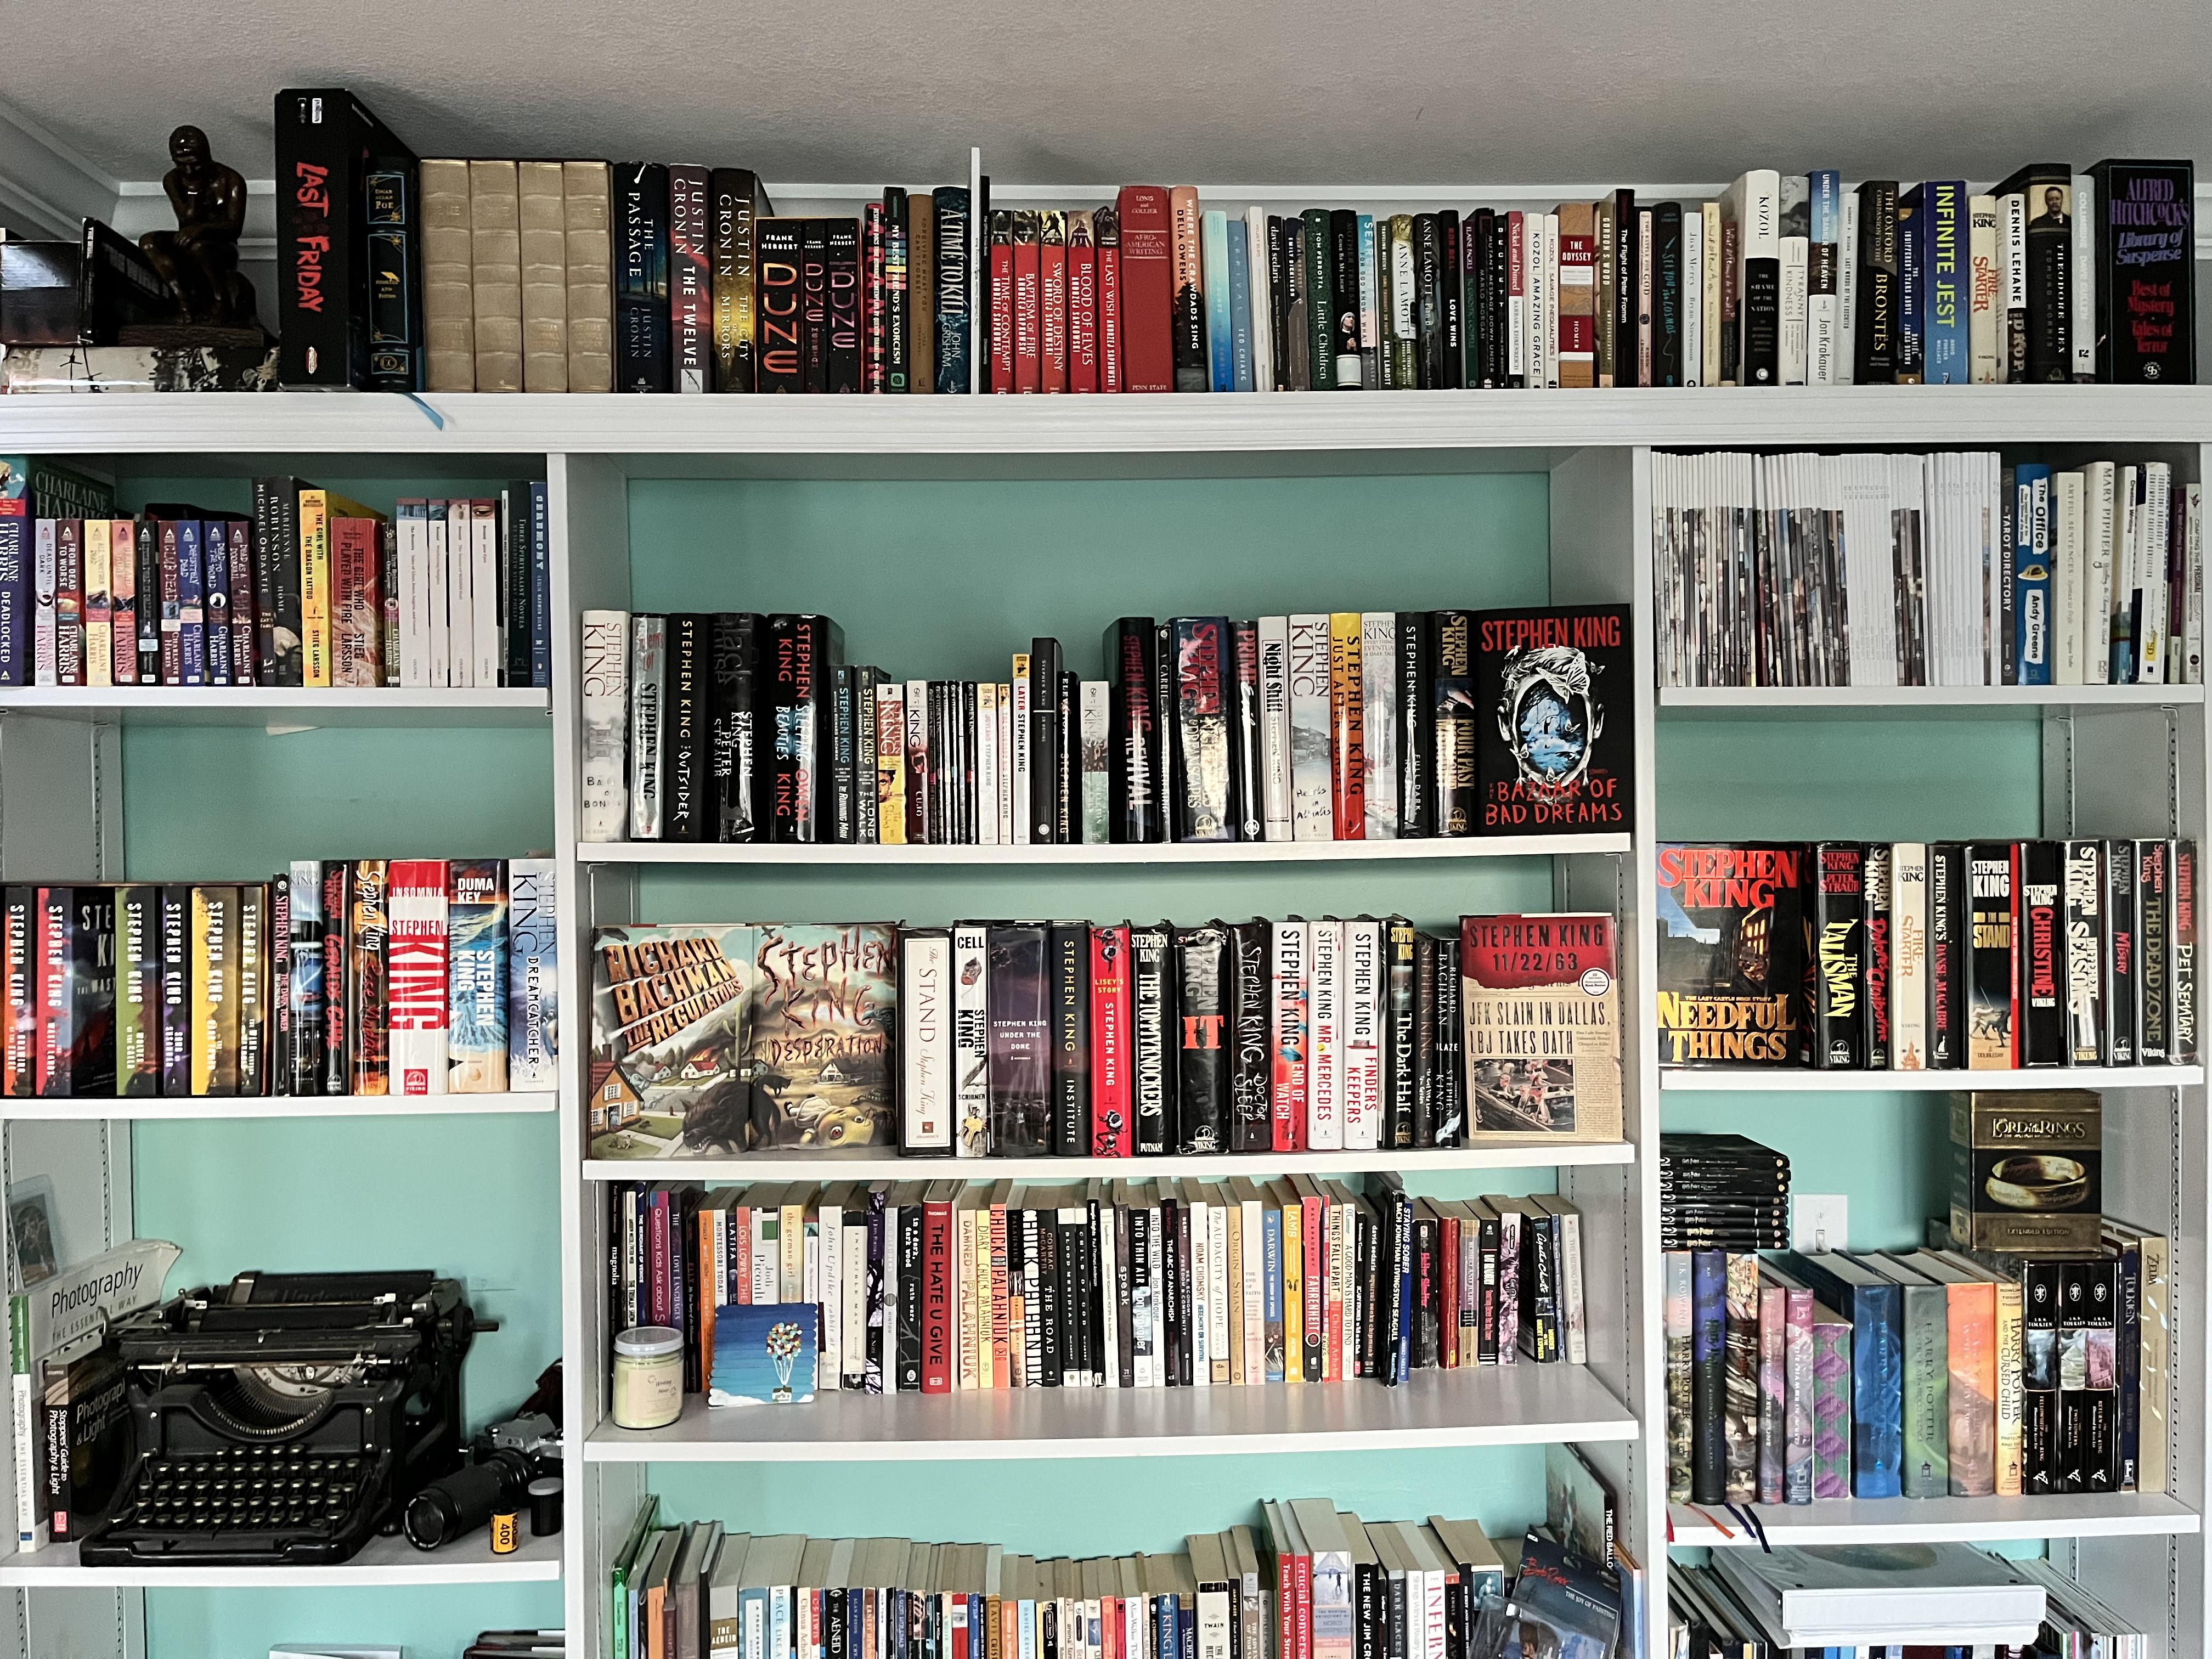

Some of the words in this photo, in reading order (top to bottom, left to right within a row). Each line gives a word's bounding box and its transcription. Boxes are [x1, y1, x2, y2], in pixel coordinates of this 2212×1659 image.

[296, 161, 329, 218] LAST
[375, 201, 394, 210] POE
[628, 192, 641, 277] PASSAGE
[644, 219, 653, 250] THE
[674, 178, 686, 254] CRONIN
[689, 180, 703, 255] JUSTIN
[892, 225, 899, 239] MY
[1759, 196, 1769, 240] KOZOL
[1936, 185, 1954, 274] INFINITE
[2011, 200, 2020, 246] DENNIS
[1271, 227, 1279, 251] david
[1562, 252, 1590, 261] ODYSSEY
[1570, 241, 1583, 250] THE
[2115, 249, 2181, 267] Suspense
[2118, 233, 2168, 249] Library
[2169, 230, 2183, 247] of
[296, 235, 329, 313] FRIDAY
[682, 266, 695, 295] THE
[1080, 263, 1092, 307] BLOOD
[1189, 263, 1197, 321] CRAWDADS
[2011, 252, 2021, 301] LEHANE
[763, 263, 797, 373] DUNE
[1082, 311, 1092, 328] OF
[1317, 301, 1327, 330] Little
[1937, 281, 1955, 328] JEST
[683, 304, 696, 365] TWELVE
[721, 297, 730, 358] MIRRORS
[1819, 318, 1828, 334] Jon
[1082, 333, 1093, 365] ELVES
[1318, 333, 1328, 380] Children
[1818, 337, 1831, 381] Krakauer
[2038, 483, 2046, 503] The
[2002, 514, 2011, 548] TAROT
[2035, 508, 2045, 549] Office
[59, 546, 67, 556] TO
[58, 558, 67, 587] WORSE
[1, 591, 10, 663] DEADLOCKED
[354, 633, 365, 658] STIEG
[1481, 617, 1571, 652] STEPHEN
[1573, 616, 1621, 647] KING
[341, 633, 352, 673] LARSSON
[584, 624, 605, 697] KING
[605, 623, 622, 698] STEPHEN
[682, 620, 692, 691] STEPHEN
[1263, 644, 1282, 682] Night
[1266, 684, 1283, 712] Shift
[680, 699, 691, 738] KING
[775, 706, 791, 760] BEAUTIES
[673, 752, 690, 821] OUTSIDER
[1497, 780, 1582, 802] BAZAAR
[1590, 779, 1617, 798] OF
[858, 799, 866, 838] WALK
[867, 800, 875, 837] LONG
[1486, 804, 1526, 825] BAD
[1535, 803, 1622, 823] DREAMS
[458, 878, 494, 891] DUMA
[1658, 849, 1798, 889] STEPHEN
[1972, 860, 2009, 874] STEPHEN
[392, 887, 443, 898] INSOMNIA
[458, 891, 480, 904] KEY
[1683, 878, 1775, 908] KING
[1973, 875, 2010, 898] KING
[127, 902, 142, 962] STEPHEN
[392, 920, 444, 935] STEPHEN
[957, 936, 984, 949] CELL
[603, 938, 724, 985] RICHARD
[1493, 952, 1578, 972] 11/22/63
[1819, 918, 1859, 1018] TALISMAN
[2030, 907, 2055, 997] CHRISTINE
[2176, 942, 2193, 976] PET
[127, 970, 143, 1003] KING
[389, 943, 445, 1030] KING
[612, 957, 736, 1025] BACHMAN
[1064, 941, 1075, 1006] STEPHEN
[526, 957, 539, 1065] DREAMCATCHER
[624, 1021, 652, 1054] THE
[651, 978, 744, 1046] REGULATORS
[919, 968, 937, 1042] STAND
[1469, 1001, 1491, 1025] JFK
[1497, 1001, 1533, 1025] SLAIN
[1539, 1002, 1551, 1025] IN
[1559, 1002, 1610, 1025] DALLAS,
[1657, 991, 1797, 1031] NEEDFUL
[2176, 980, 2193, 1044] SEMATARY
[769, 1032, 883, 1065] DESPERATION
[1065, 1013, 1075, 1052] KING
[1183, 1015, 1224, 1049] IT
[1470, 1030, 1492, 1054] LBJ
[1499, 1030, 1536, 1054] TAKES
[1543, 1031, 1573, 1054] OATH
[1668, 1030, 1787, 1062] THINGS
[1291, 1064, 1304, 1085] END
[1317, 1054, 1331, 1121] MERCEDES
[1364, 1057, 1376, 1111] FINDERS
[1066, 1080, 1075, 1143] INSTITUTE
[1276, 1082, 1290, 1120] WATCH
[1291, 1088, 1304, 1103] OF
[1347, 1067, 1361, 1124] KEEPERS
[930, 1224, 944, 1255] THE
[978, 1226, 989, 1251] DIARY
[1135, 1217, 1144, 1238] INTO
[1332, 1210, 1341, 1235] THINGS
[2007, 1227, 2040, 1235] EXTENDED
[610, 1246, 619, 1285] magnolia
[1135, 1242, 1144, 1266] THIN
[1267, 1229, 1276, 1272] DARWIN
[51, 1261, 143, 1318] Photography
[754, 1255, 765, 1300] Picoult
[930, 1262, 944, 1304] HATE
[977, 1263, 989, 1290] CHUCK
[1118, 1266, 1128, 1306] speak
[1135, 1268, 1144, 1284] AIR
[1331, 1261, 1340, 1291] APART
[930, 1310, 943, 1320] U
[1045, 1286, 1054, 1312] THE
[978, 1296, 991, 1343] PALAHNIUK
[1045, 1318, 1054, 1354] ROAD
[930, 1326, 943, 1365] GIVE
[2010, 1317, 2021, 1367] HARRY
[2011, 1370, 2021, 1425] POTTER
[500, 1523, 511, 1545] 400
[831, 1617, 841, 1654] AENEID
